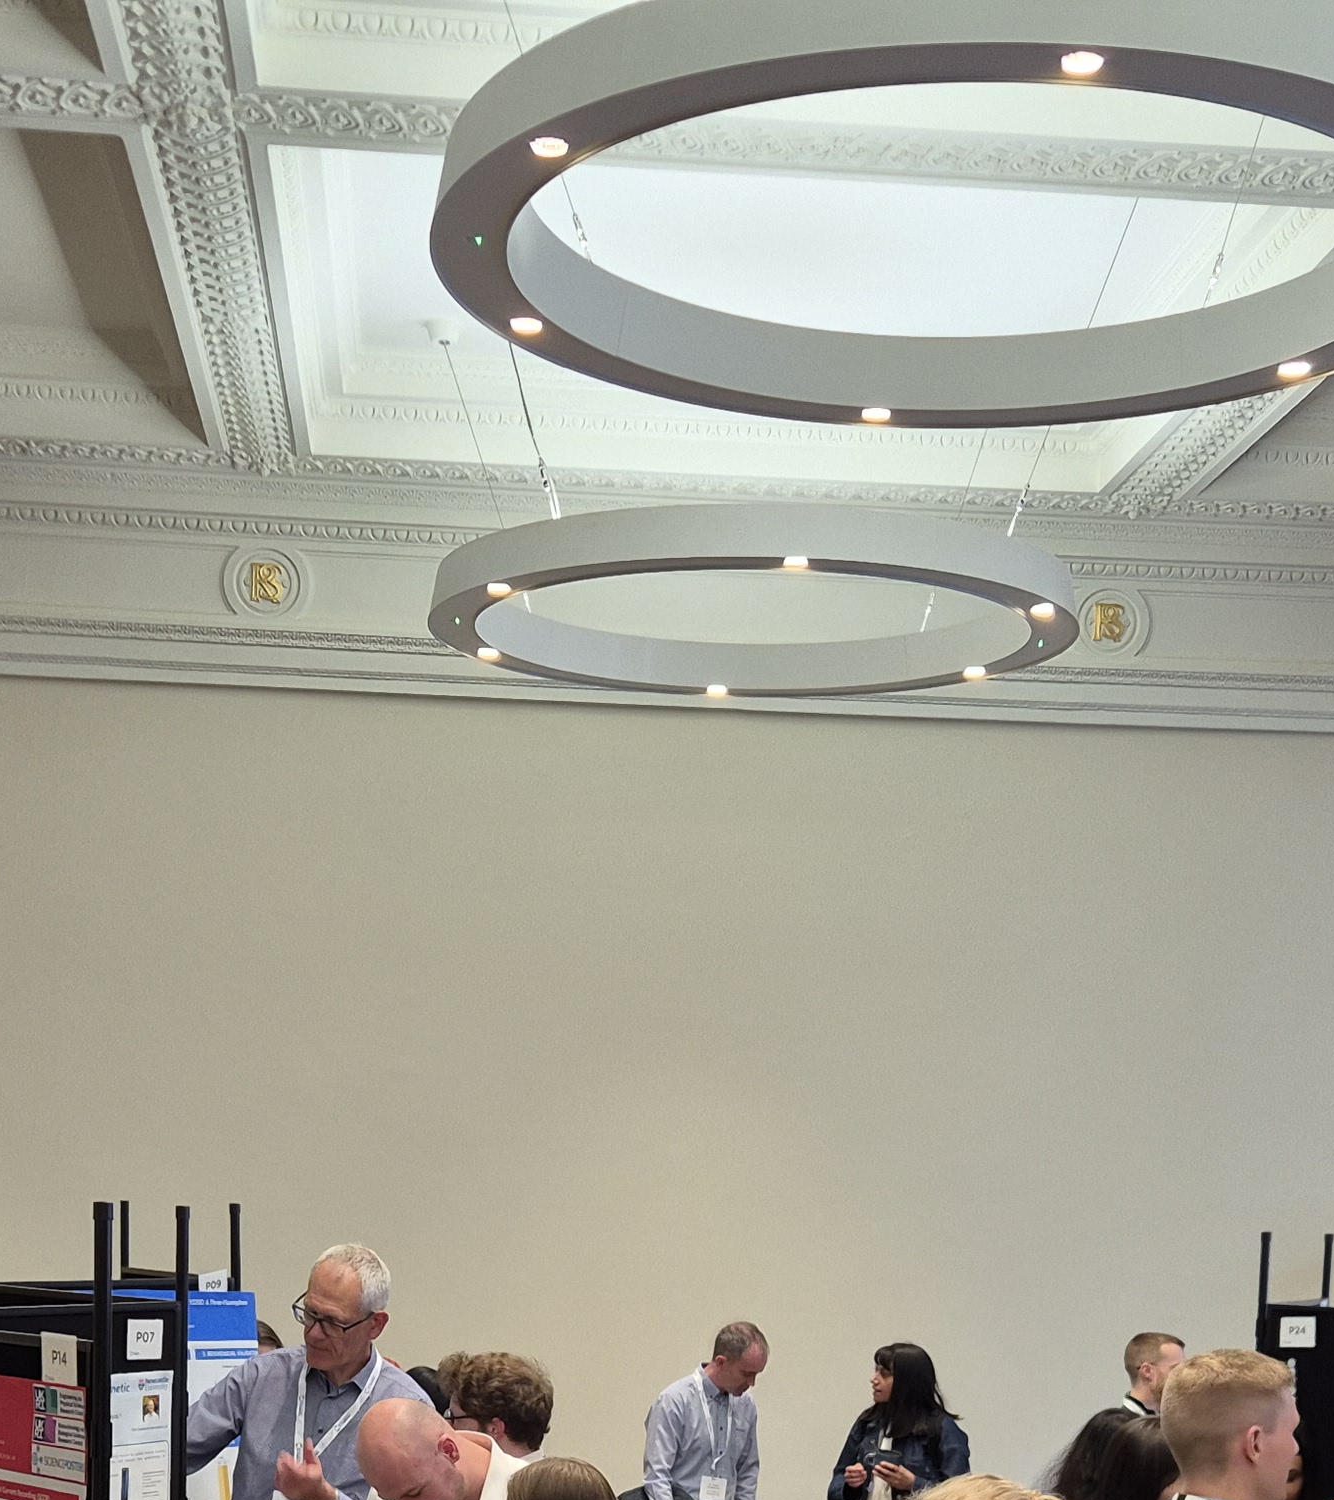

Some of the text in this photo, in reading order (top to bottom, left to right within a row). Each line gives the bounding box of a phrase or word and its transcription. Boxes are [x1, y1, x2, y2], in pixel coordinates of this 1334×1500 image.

[206, 1280, 221, 1290] P09
[1288, 1325, 1306, 1335] P24
[136, 1331, 155, 1343] P07
[51, 1350, 68, 1366] P14
